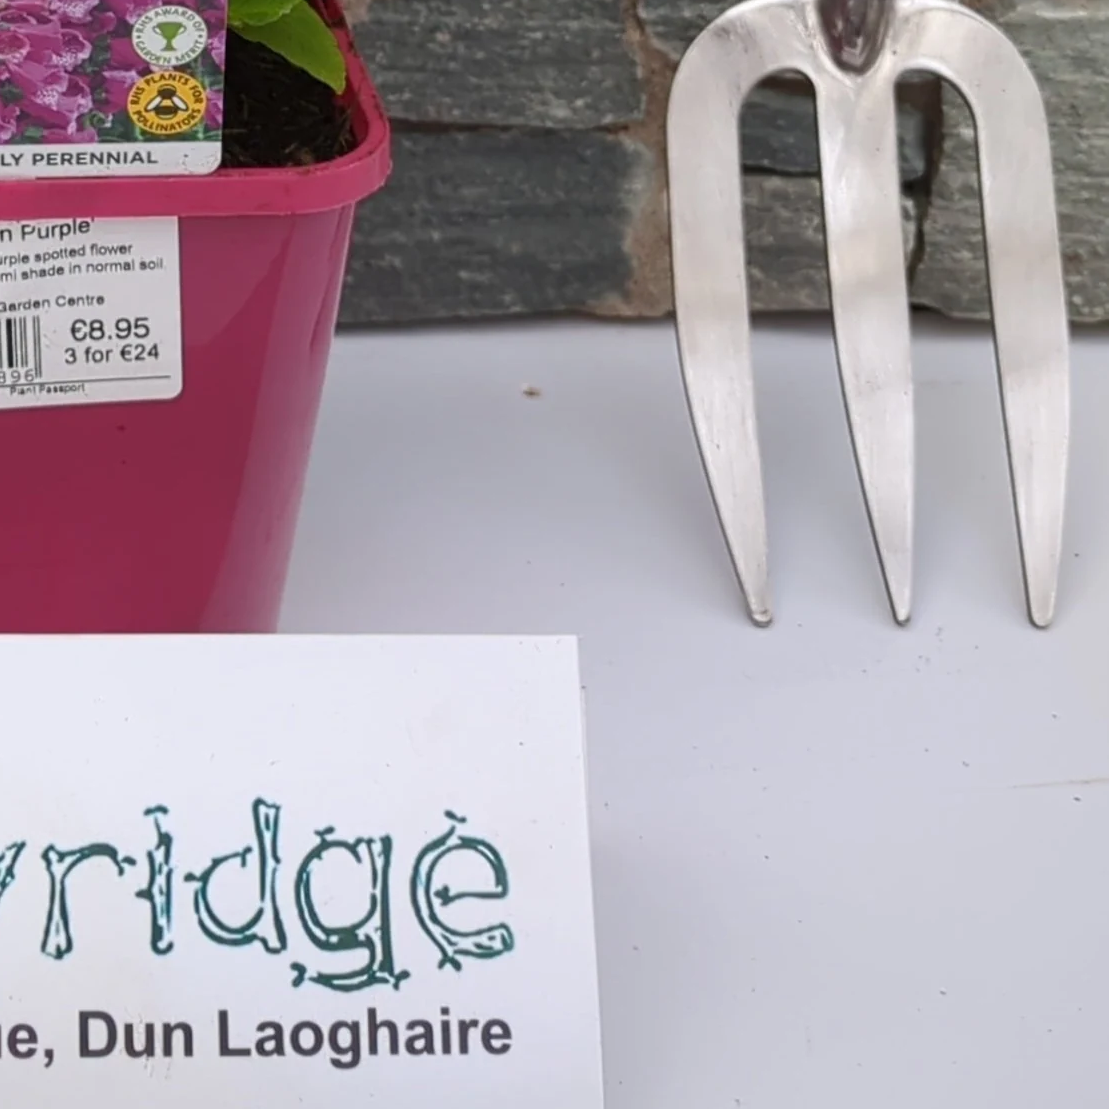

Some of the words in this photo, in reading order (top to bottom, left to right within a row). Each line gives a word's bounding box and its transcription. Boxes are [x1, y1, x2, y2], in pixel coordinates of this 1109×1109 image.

[135, 15, 153, 34] RHS
[154, 8, 196, 23] AWARD
[136, 40, 171, 64] GARDEN
[175, 39, 204, 63] MERIT
[130, 86, 145, 105] RHS
[144, 73, 189, 86] PLANTS
[189, 85, 204, 104] FOR
[132, 108, 201, 132] POLLINATORS
[31, 150, 159, 167] PERENNIAL
[34, 245, 86, 263] spotted
[90, 243, 133, 256] flower
[21, 264, 65, 279] shade
[69, 262, 82, 275] in
[86, 259, 135, 273] normal
[55, 293, 105, 307] Centre
[70, 317, 150, 341] €8.95
[64, 347, 77, 364] 3
[84, 346, 113, 363] for
[120, 343, 159, 362] €24
[41, 383, 86, 395] Passport
[77, 1010, 194, 1059] Dun
[217, 1006, 513, 1069] Laoghaire
